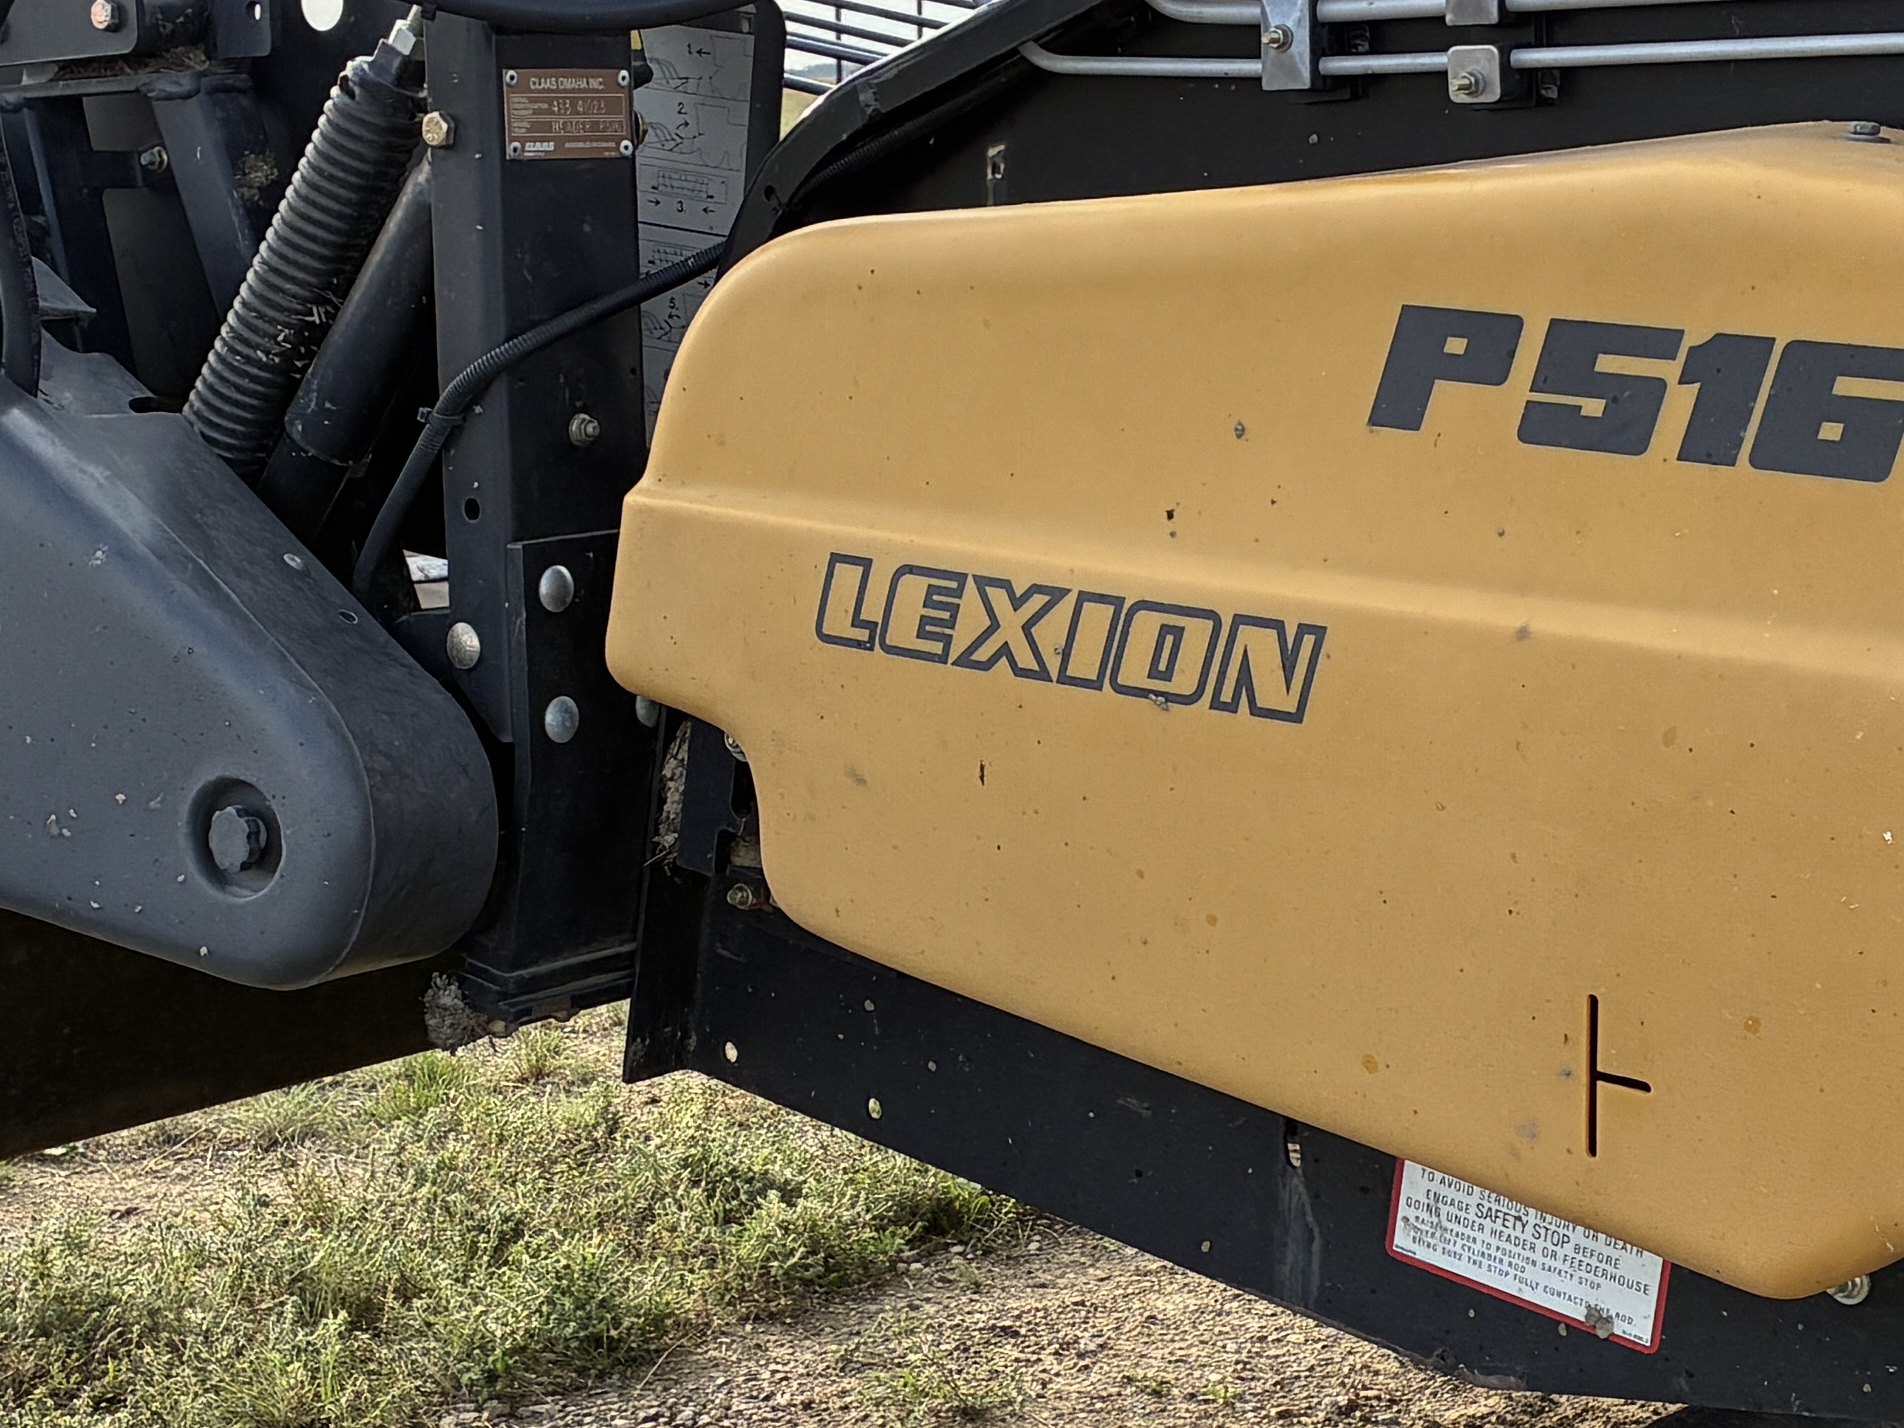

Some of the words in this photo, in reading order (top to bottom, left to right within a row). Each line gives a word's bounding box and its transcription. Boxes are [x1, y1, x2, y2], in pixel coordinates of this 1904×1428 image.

[530, 77, 556, 90] CLAAS
[558, 77, 588, 90] OMAHA
[815, 551, 1328, 725] LEXION
[1406, 1196, 1441, 1218] GOING
[1447, 1210, 1484, 1234] UNDER
[1490, 1227, 1536, 1253] HEADER
[1542, 1246, 1557, 1262] OR
[1563, 1253, 1652, 1296] FEEDERHOUSE
[1421, 1168, 1435, 1182] TO
[1439, 1176, 1474, 1196] AVOID
[1479, 1190, 1529, 1217] SERIOUS
[1534, 1210, 1577, 1234] INJURY
[1583, 1229, 1599, 1242] OR
[1605, 1235, 1644, 1258] DEATH
[1426, 1189, 1471, 1215] ENGAGE
[1475, 1203, 1529, 1234] SAFETY
[1532, 1222, 1571, 1249] STOP
[1574, 1243, 1621, 1270] BEFORE
[1461, 1243, 1504, 1266] CYLINDER
[1508, 1260, 1526, 1274] ROD
[1482, 1240, 1492, 1251] TO
[1496, 1245, 1537, 1268] POSITION
[1541, 1262, 1574, 1282] SAFETY
[1578, 1276, 1602, 1291] STOP
[1486, 1263, 1510, 1278] STOP
[1513, 1273, 1540, 1292] FULLY
